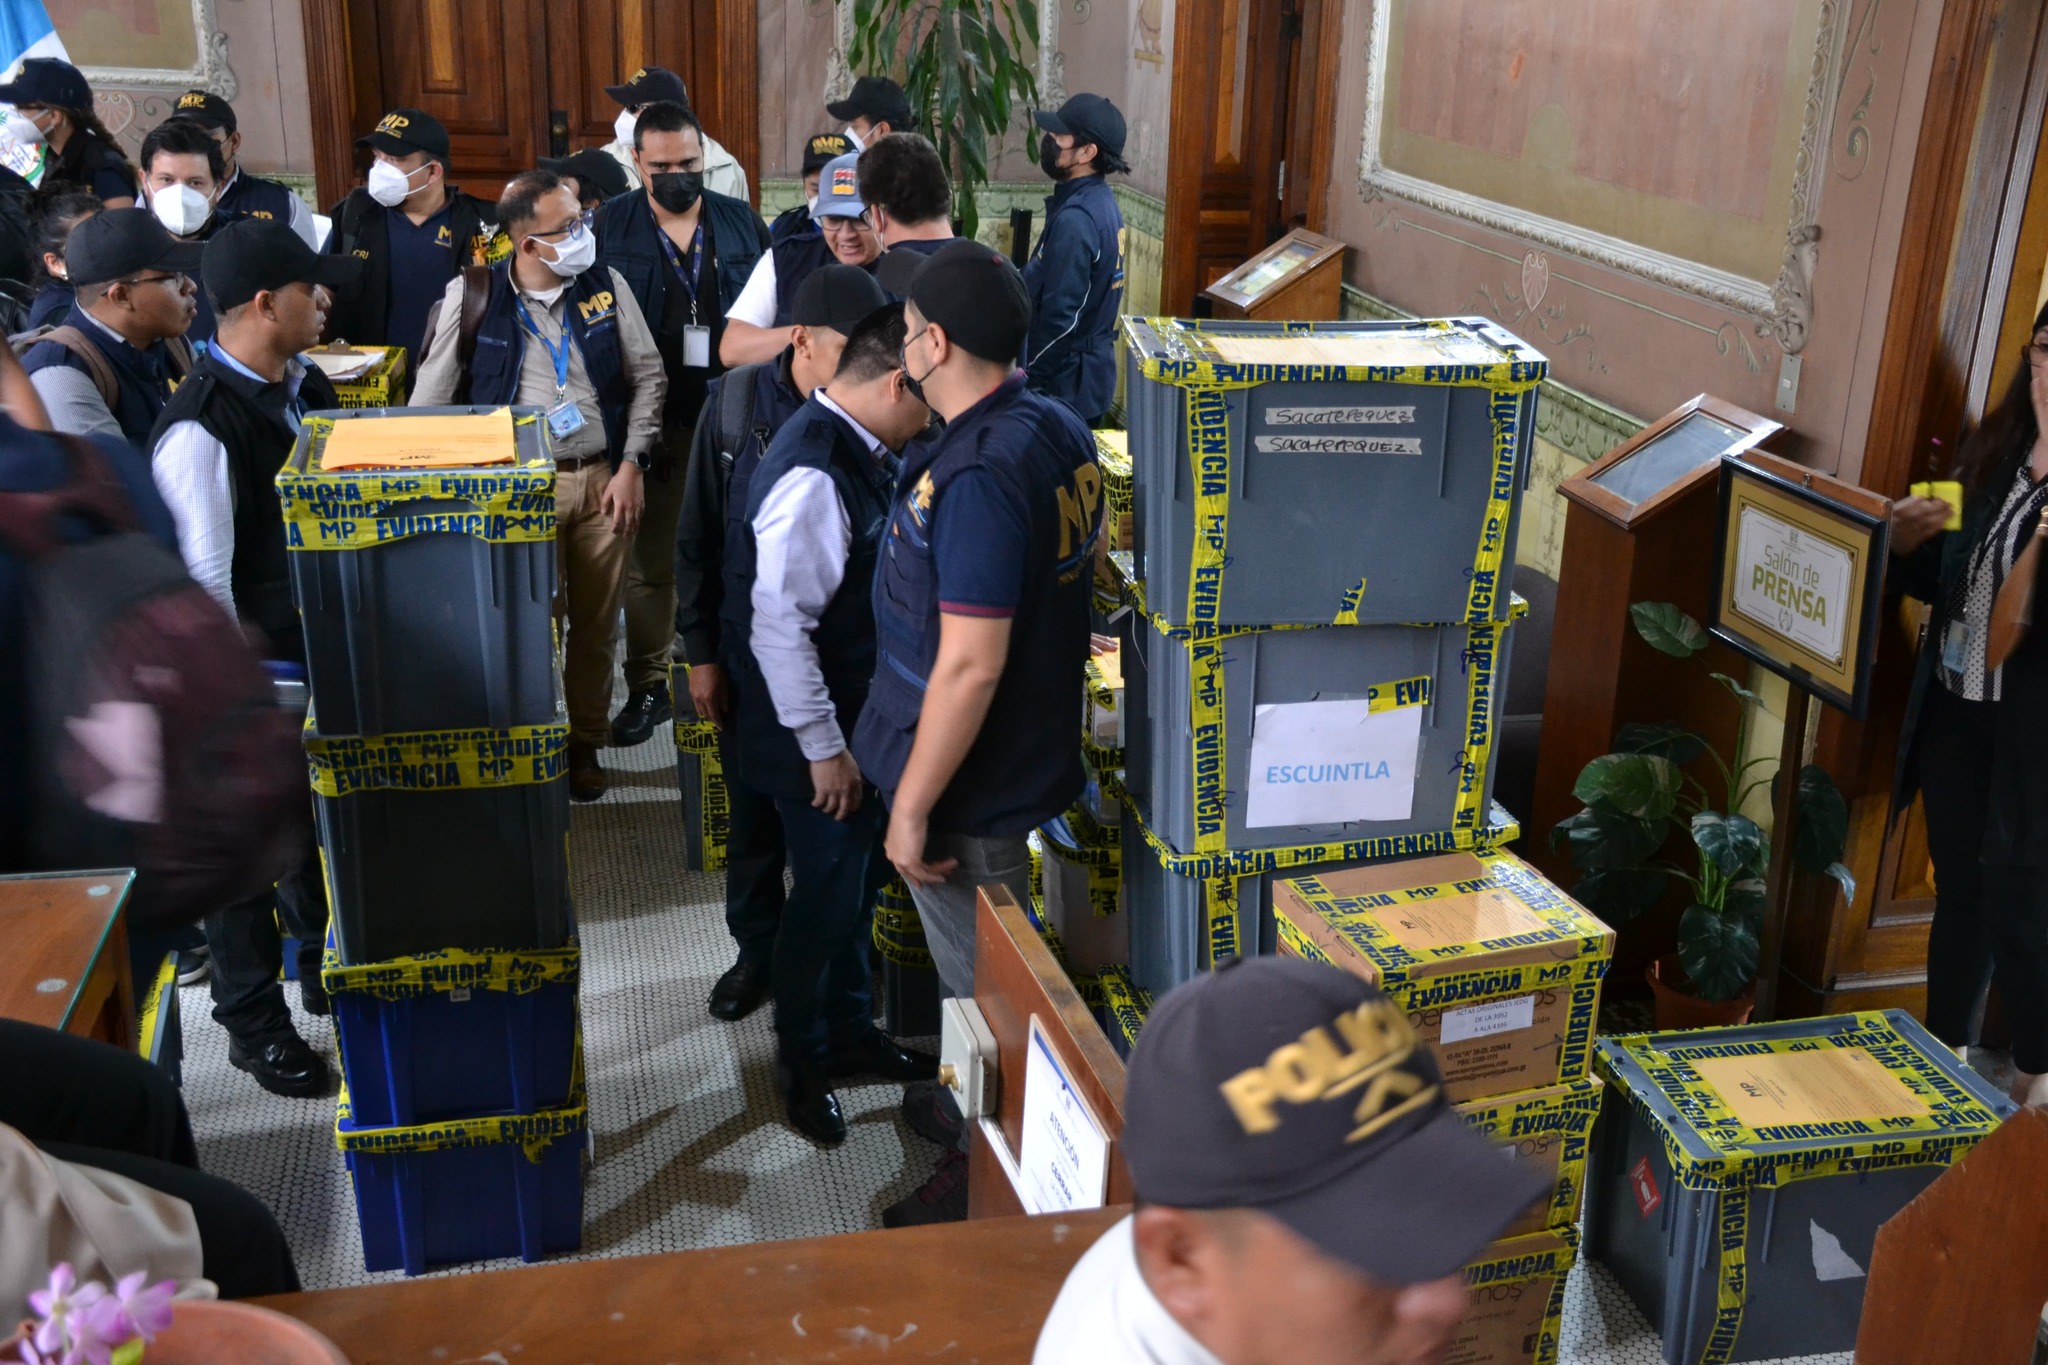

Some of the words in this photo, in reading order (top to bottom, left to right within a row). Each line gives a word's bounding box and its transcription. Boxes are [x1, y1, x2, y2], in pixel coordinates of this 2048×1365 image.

[380, 113, 409, 128] MP
[438, 225, 452, 242] M
[577, 291, 613, 319] MP
[1159, 361, 1197, 377] MP
[1214, 364, 1347, 382] EVIDENCIA
[1368, 366, 1405, 381] MP
[381, 480, 421, 493] MP
[1056, 462, 1100, 558] MP
[320, 521, 357, 540] MP
[377, 514, 507, 541] EVIDENCIA
[1206, 514, 1226, 551] MP
[1482, 517, 1501, 552] MP
[1764, 545, 1799, 584] Salón
[1803, 563, 1820, 589] de
[1752, 564, 1827, 626] PRENSA
[1199, 674, 1218, 708] MP
[422, 743, 459, 760] MP
[334, 763, 461, 793] EVIDENCIA
[478, 759, 515, 778] MP
[1194, 724, 1223, 838] EVIDENCIA
[1266, 761, 1390, 785] ESCUINTLA
[1167, 851, 1277, 880] EVIDENCIA
[1294, 847, 1327, 862] MP
[1344, 832, 1457, 860] EVIDENCIA
[1405, 886, 1439, 899] MP
[1432, 945, 1466, 957] MP
[1540, 966, 1572, 982] MP
[1407, 973, 1522, 1009] EVIDENCIA
[1456, 1008, 1475, 1017] ACTAS
[1477, 1001, 1512, 1013] ORIGINALES
[1561, 981, 1596, 1078] EVIDENCI
[1669, 1042, 1775, 1061] EVIDENCIA
[1788, 1042, 1820, 1052] MP
[1740, 1082, 1762, 1097] MP
[1900, 1077, 1928, 1095] MP
[1693, 1091, 1719, 1109] MP
[1050, 1111, 1079, 1170] ATENCIÓN
[1752, 1121, 1874, 1141] EVIDENCIA
[1880, 1116, 1915, 1128] MP
[1742, 1147, 1854, 1169] EVIDENCIA
[1873, 1142, 1905, 1155] MP
[1729, 1263, 1745, 1294] MP
